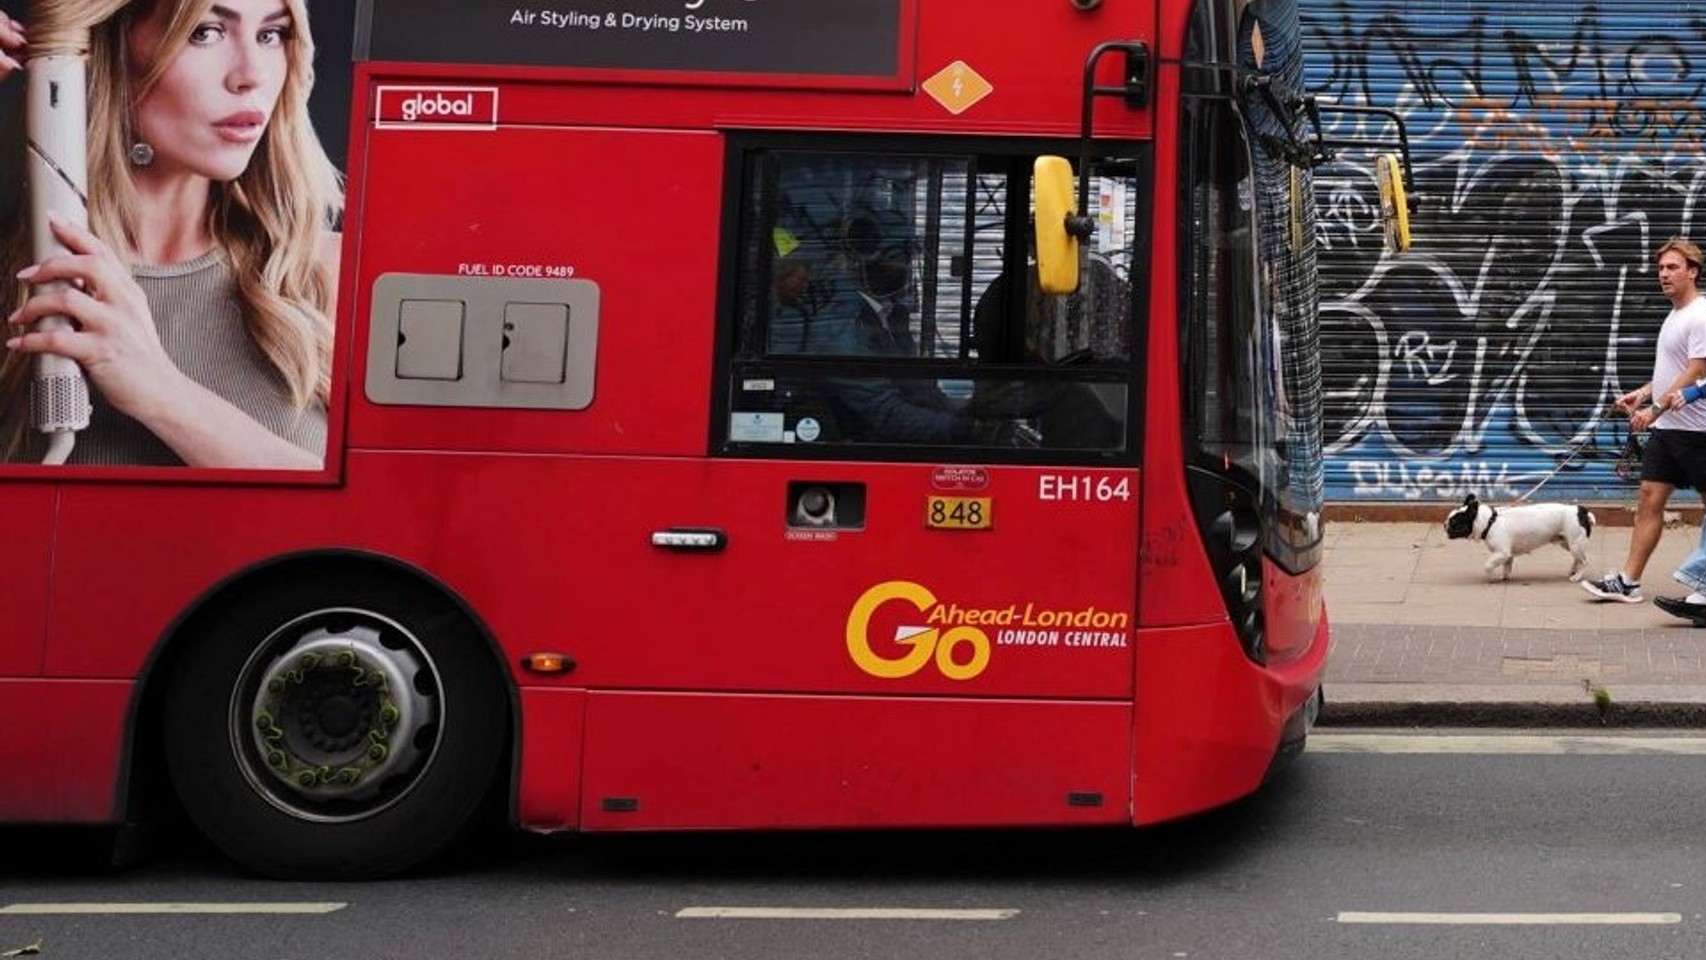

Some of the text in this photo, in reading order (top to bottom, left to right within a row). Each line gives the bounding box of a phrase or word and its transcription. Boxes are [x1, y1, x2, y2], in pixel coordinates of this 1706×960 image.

[510, 9, 748, 31] Air Styling & Drying System
[402, 93, 473, 120] global
[458, 263, 574, 277] FUEL ID CODE 9489
[1039, 475, 1131, 501] EH164
[931, 499, 983, 525] 848
[846, 581, 1128, 680] Go Ahead-London
[997, 630, 1128, 647] LONDON CENTRAL
